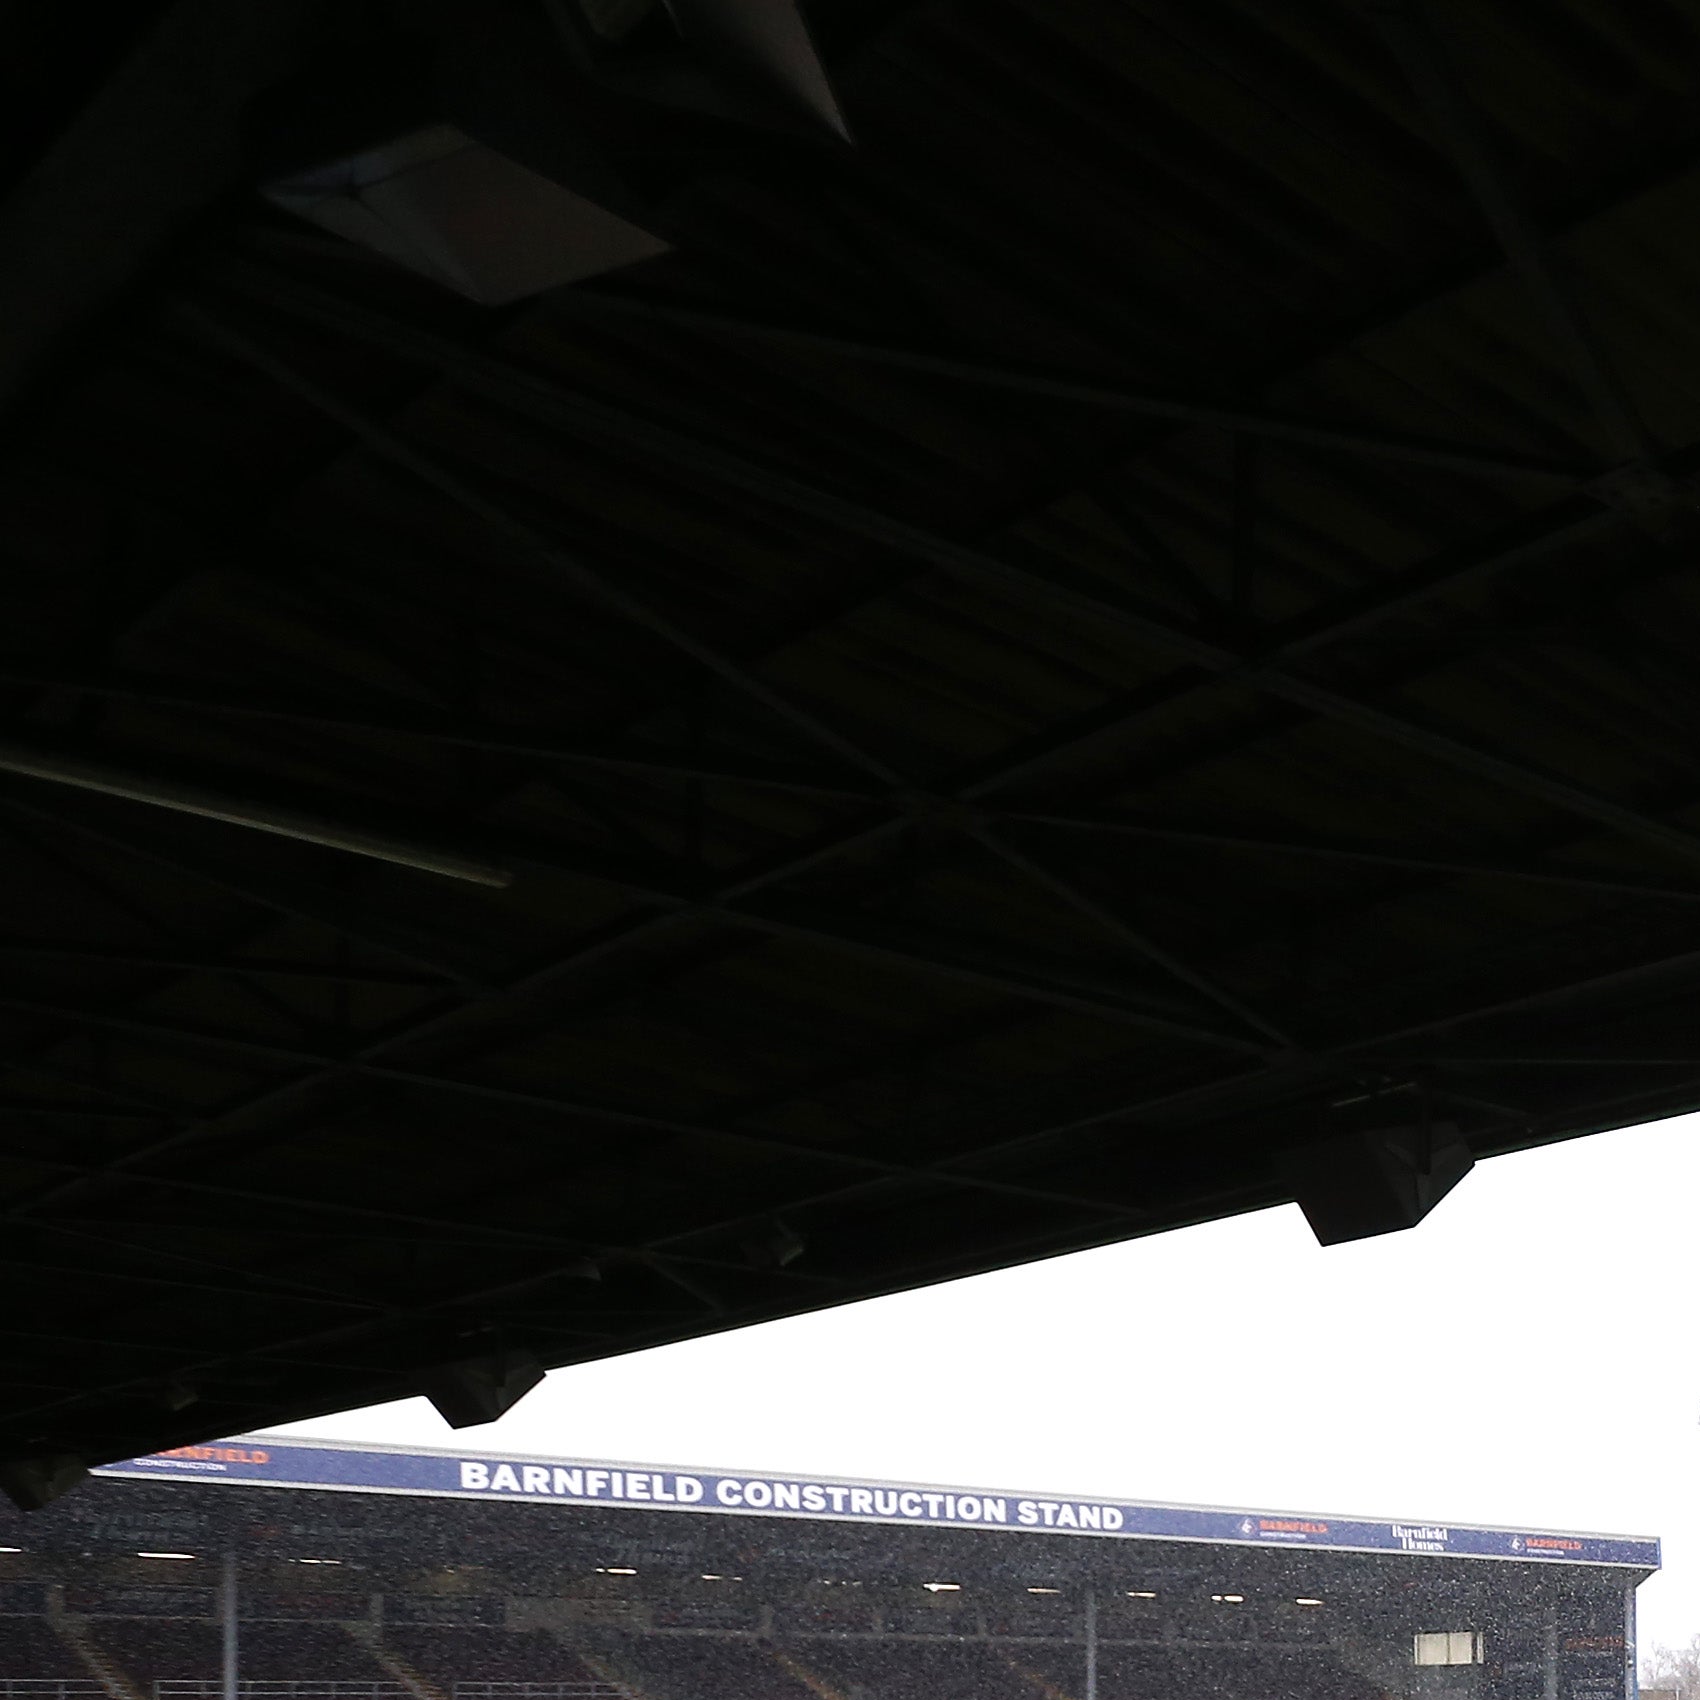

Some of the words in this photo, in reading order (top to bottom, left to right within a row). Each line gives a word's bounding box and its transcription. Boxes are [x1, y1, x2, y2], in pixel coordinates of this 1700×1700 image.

[459, 1462, 703, 1502] BARNFIELD
[716, 1479, 1006, 1522] CONSTRUCTION
[1017, 1501, 1124, 1530] STAND
[1392, 1525, 1448, 1541] Barnfield
[1401, 1538, 1445, 1551] Homes
